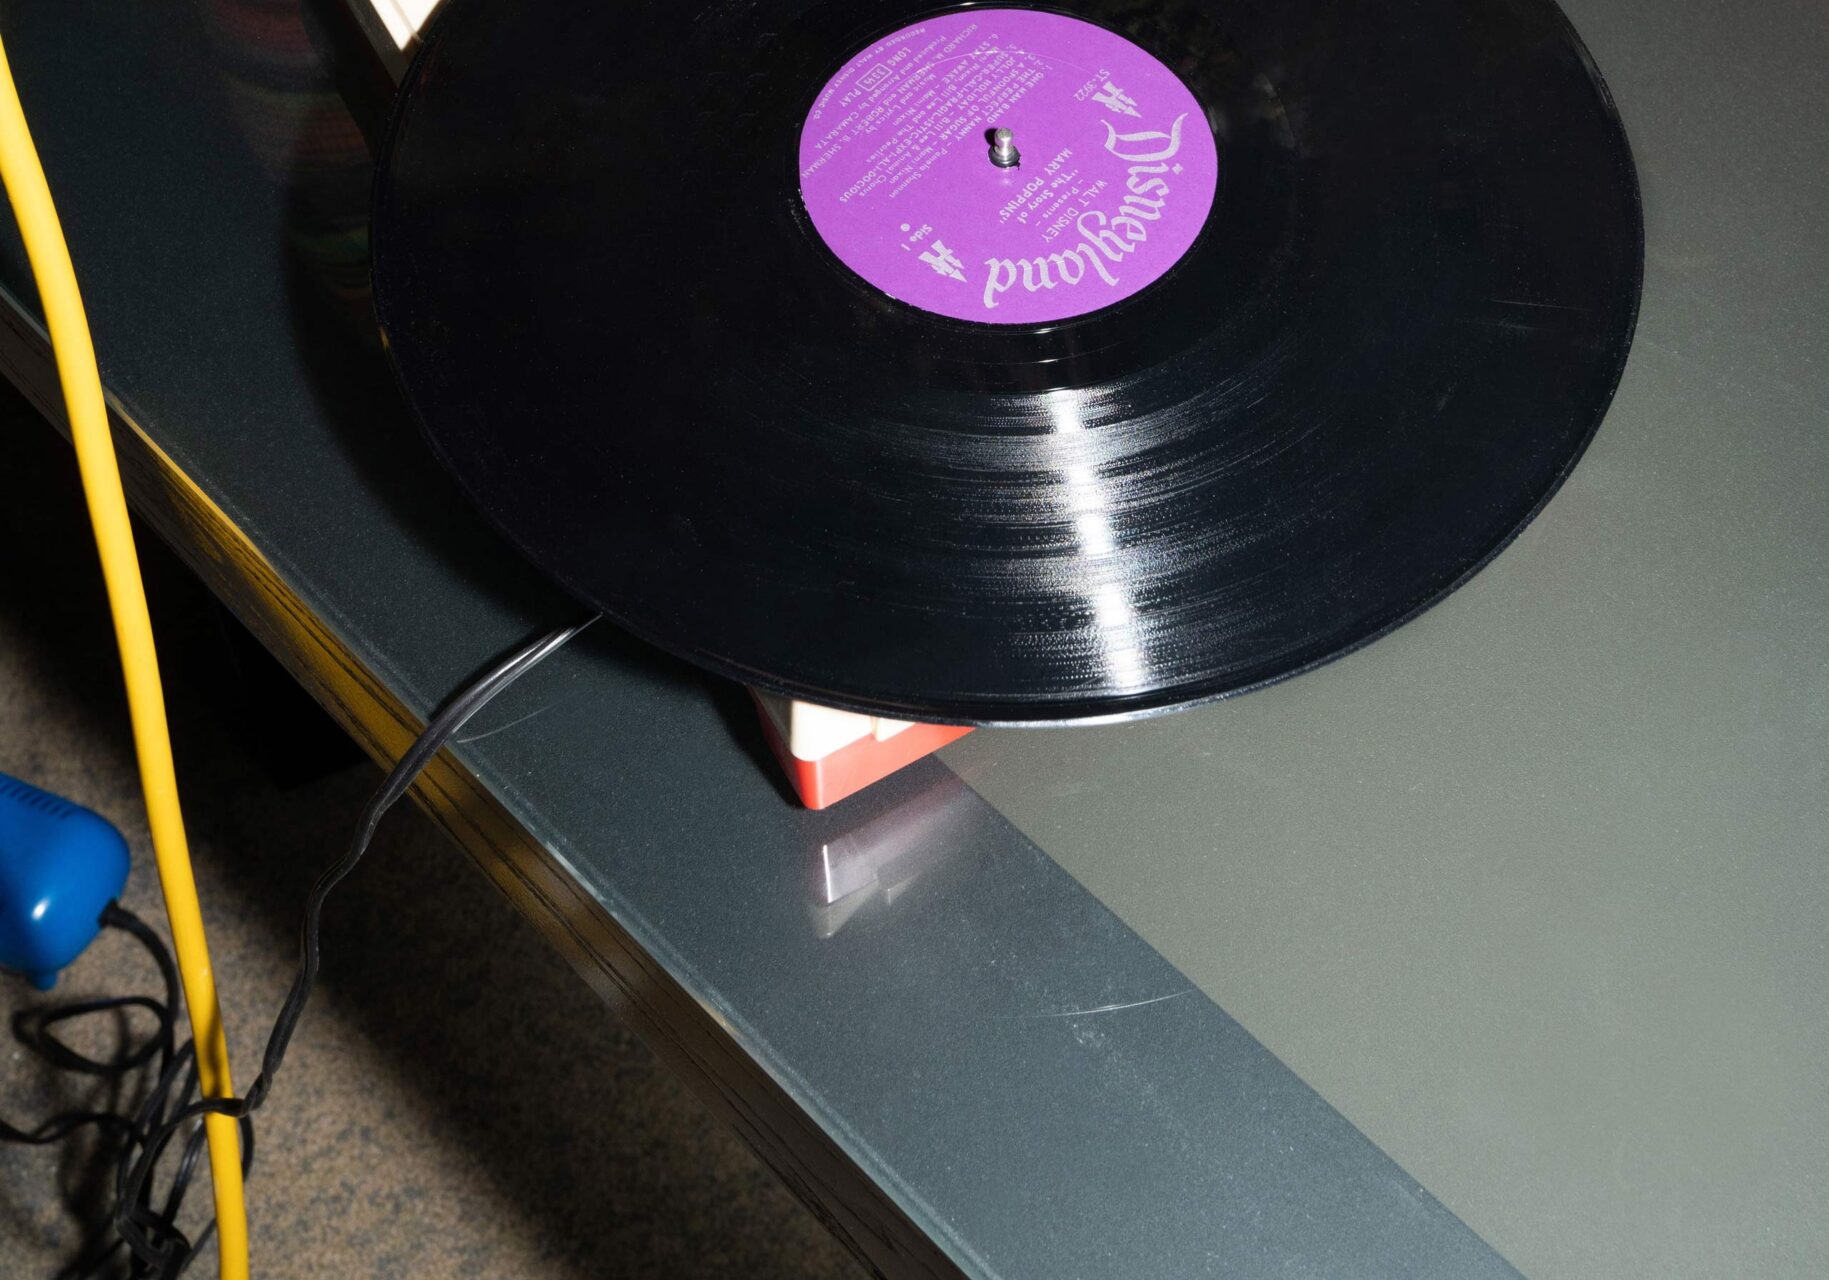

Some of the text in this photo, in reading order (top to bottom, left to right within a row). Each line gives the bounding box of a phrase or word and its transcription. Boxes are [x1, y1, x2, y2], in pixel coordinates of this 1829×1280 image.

[836, 87, 861, 107] PLAY
[1043, 147, 1072, 176] MARY
[1027, 189, 1054, 210] Story
[983, 112, 1189, 309] Disneyland
[1015, 211, 1027, 224] of
[1040, 179, 1107, 243] WALT DISNEY
[908, 223, 933, 241] Side
